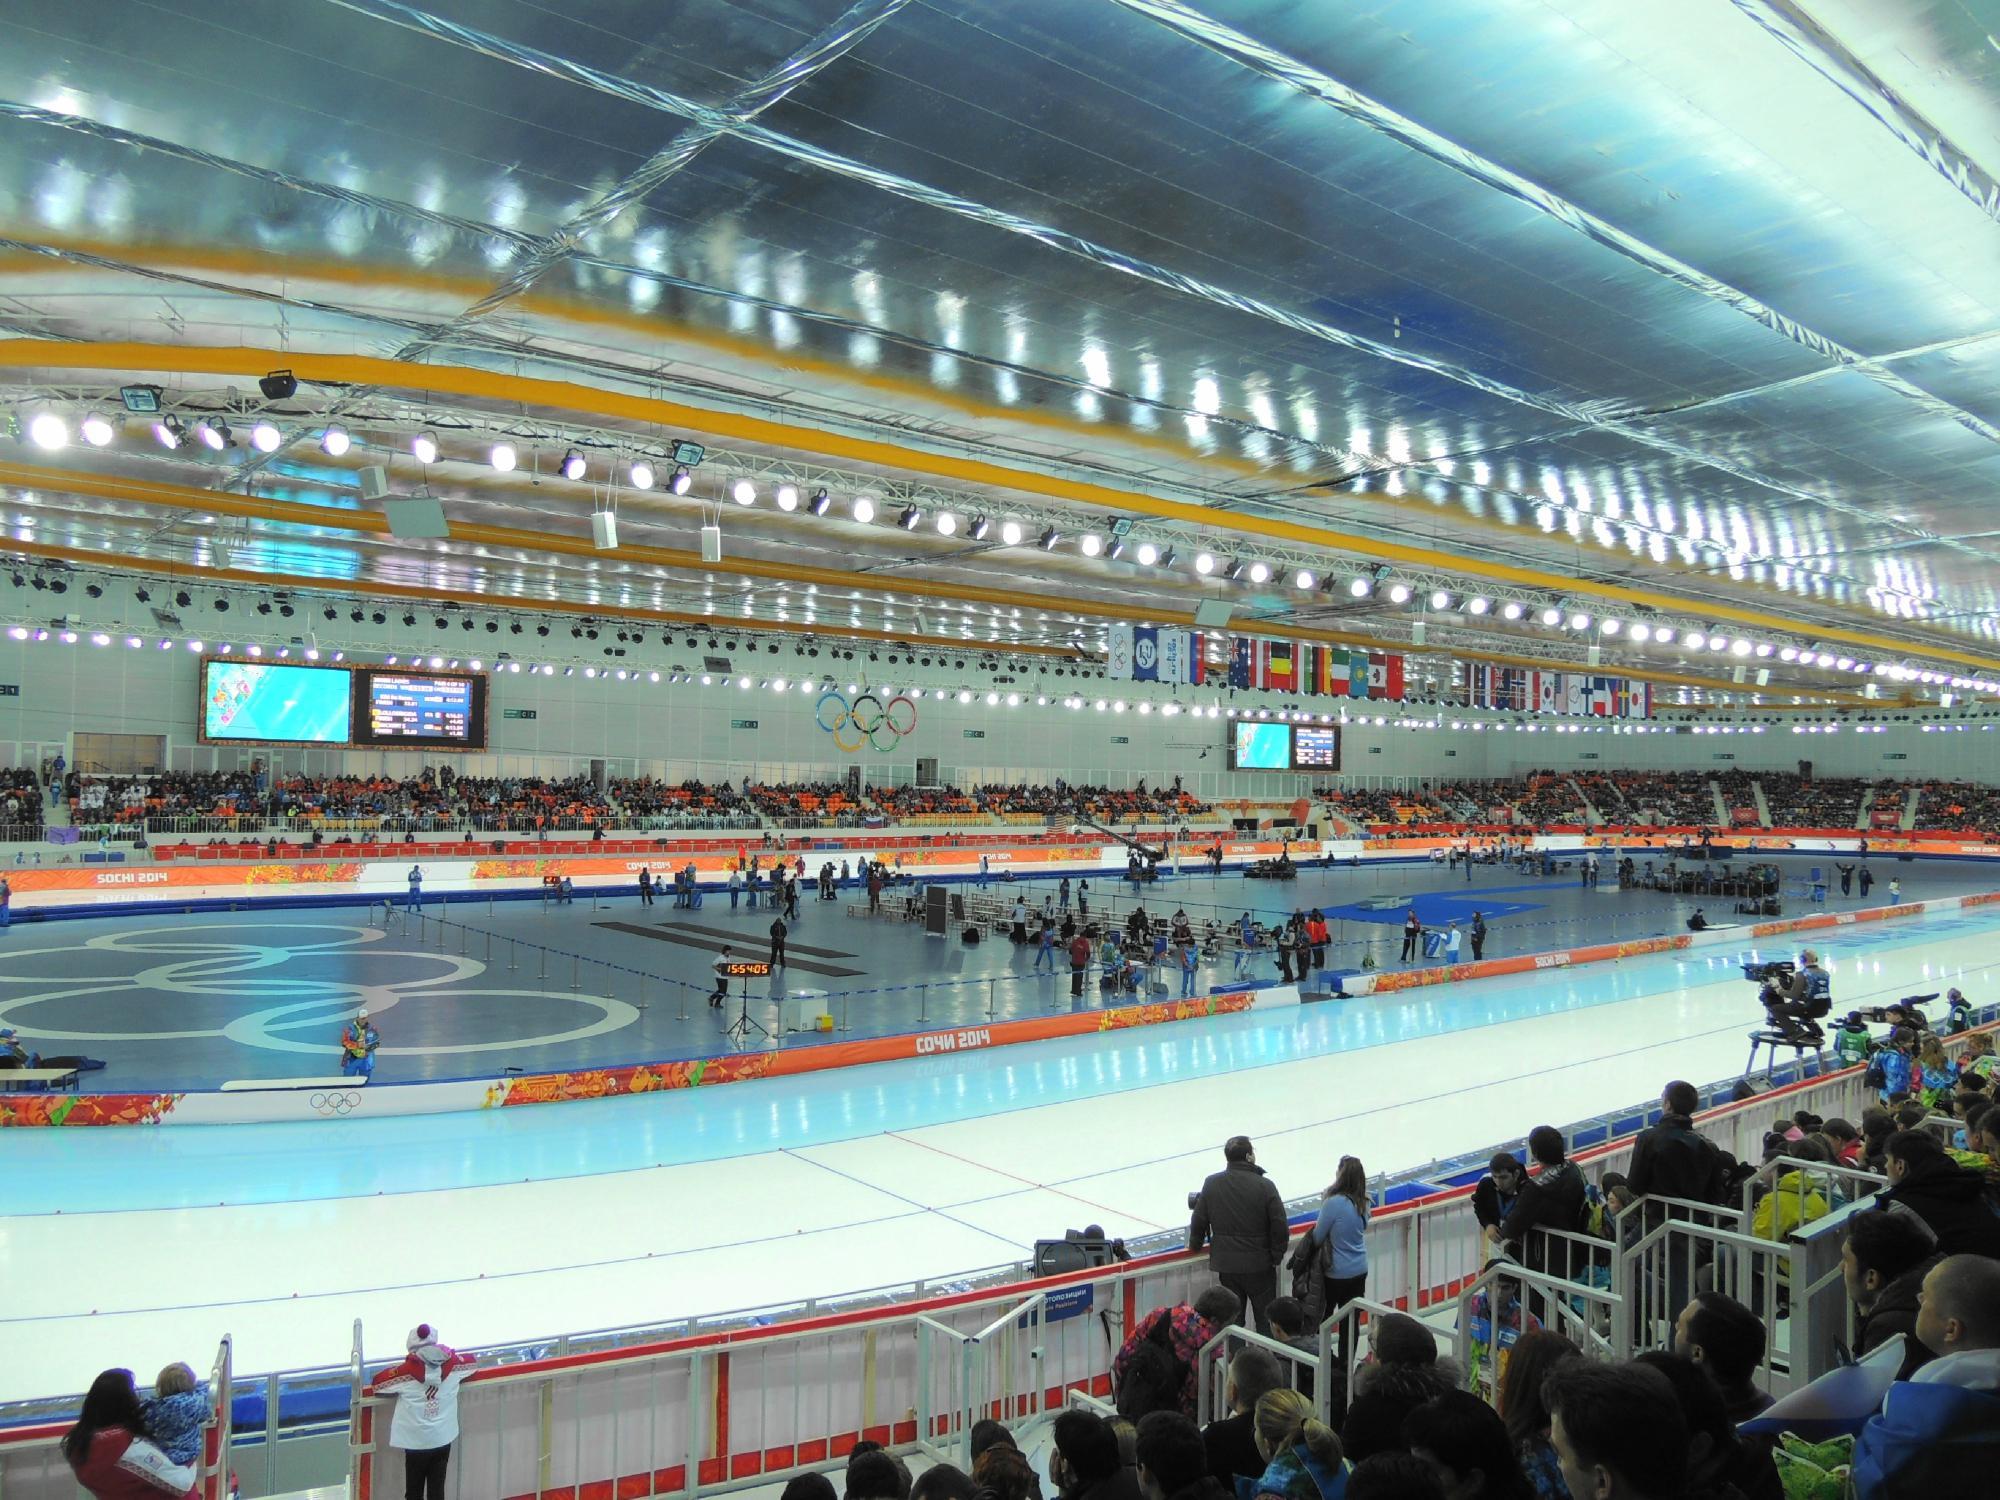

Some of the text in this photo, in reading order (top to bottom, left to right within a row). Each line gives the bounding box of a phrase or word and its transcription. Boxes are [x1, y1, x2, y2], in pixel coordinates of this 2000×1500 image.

[96, 872, 168, 884] SOCHI 2014
[916, 1028, 991, 1054] СОЧИ 2014
